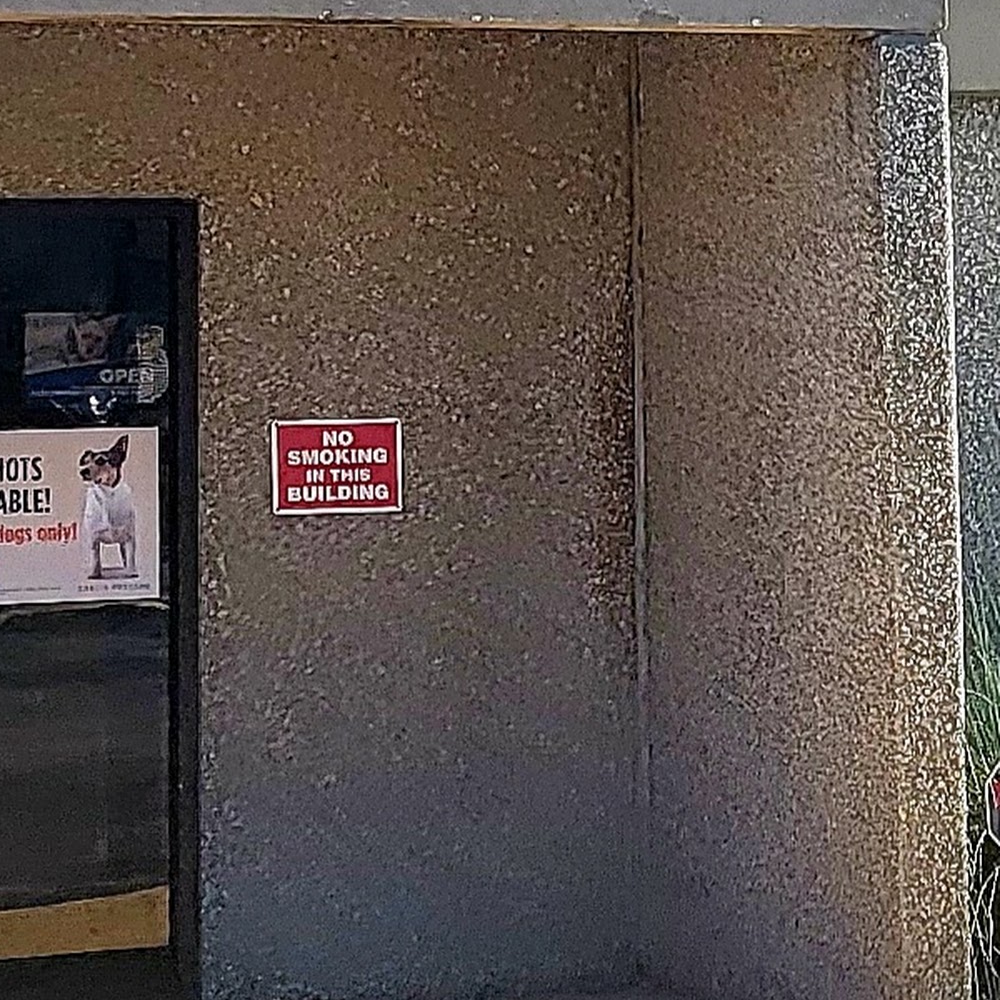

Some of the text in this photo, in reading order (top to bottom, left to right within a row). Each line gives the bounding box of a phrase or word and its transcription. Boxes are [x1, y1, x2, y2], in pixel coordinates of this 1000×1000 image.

[322, 430, 354, 447] NO
[287, 447, 388, 465] SMOKING
[306, 467, 371, 483] IN THIS
[287, 483, 389, 502] BUILDING
[37, 522, 78, 545] only!
